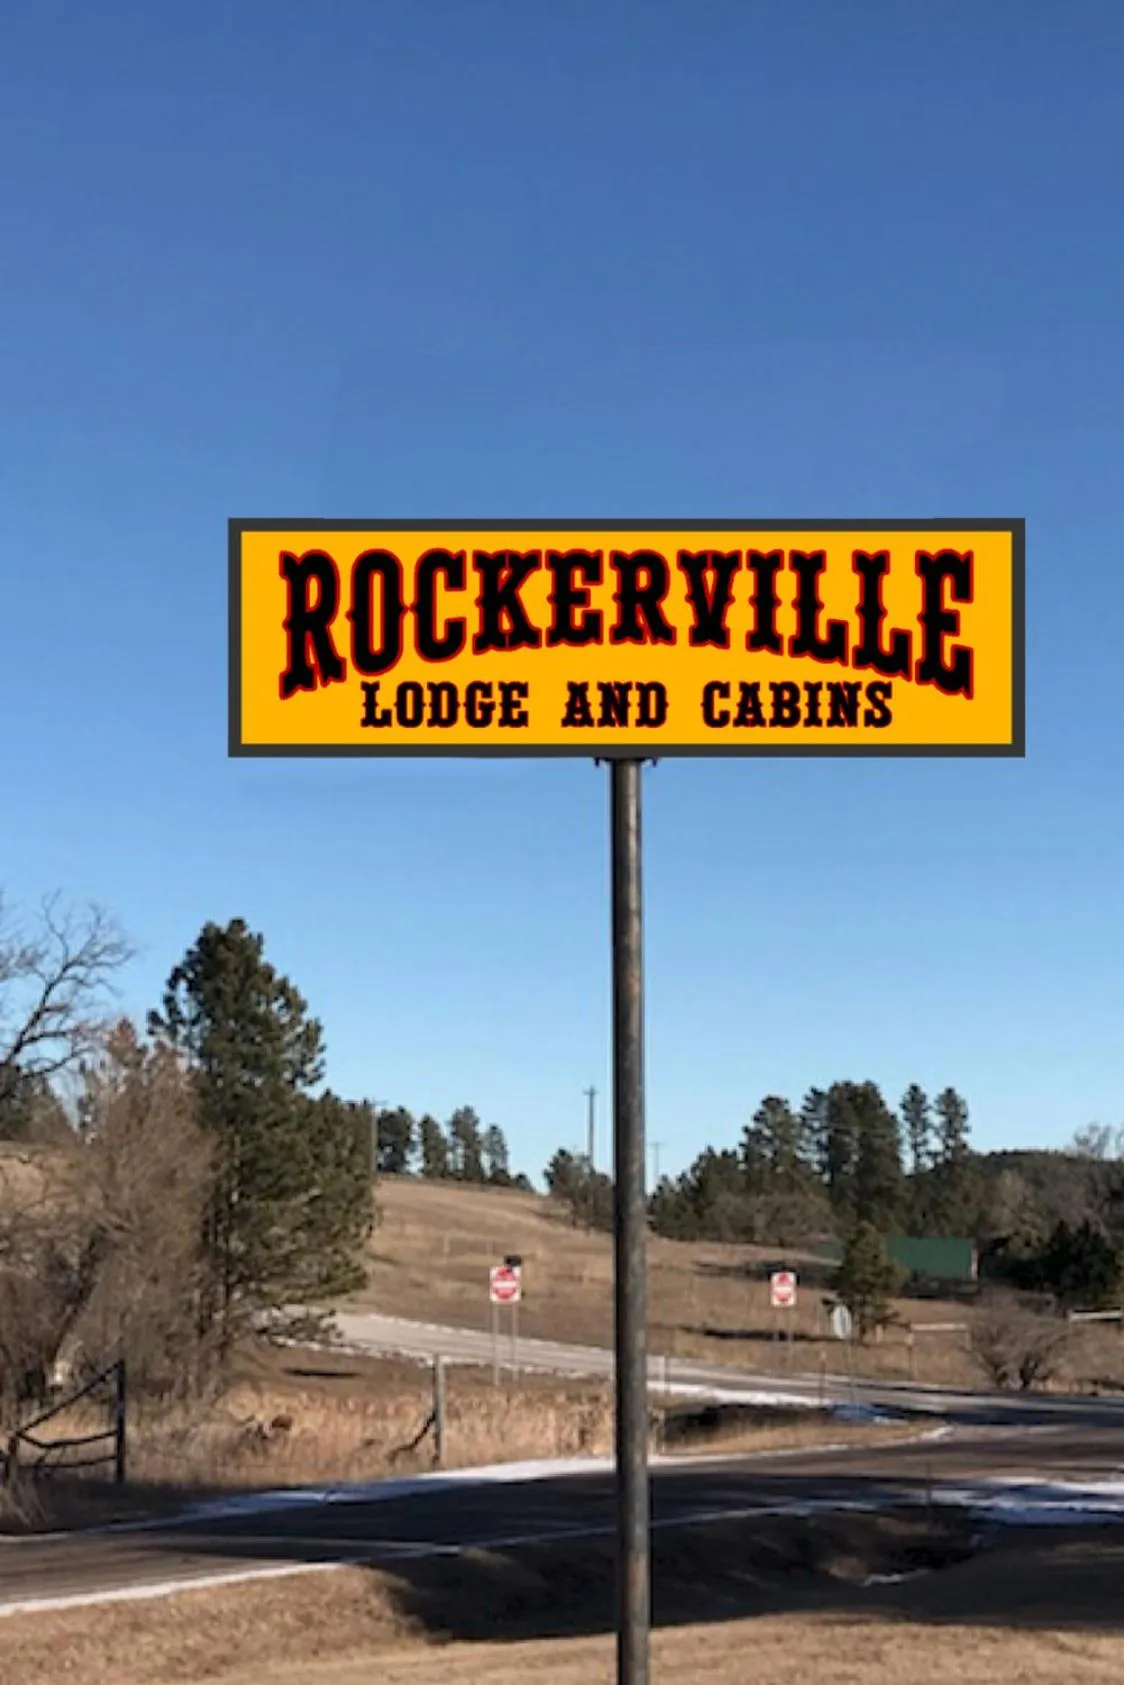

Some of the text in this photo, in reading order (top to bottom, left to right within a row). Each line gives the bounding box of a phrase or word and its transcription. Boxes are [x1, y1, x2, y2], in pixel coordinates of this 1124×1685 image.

[279, 548, 975, 701] ROCKERVILLE
[360, 680, 893, 729] LODGE AND CABINS
